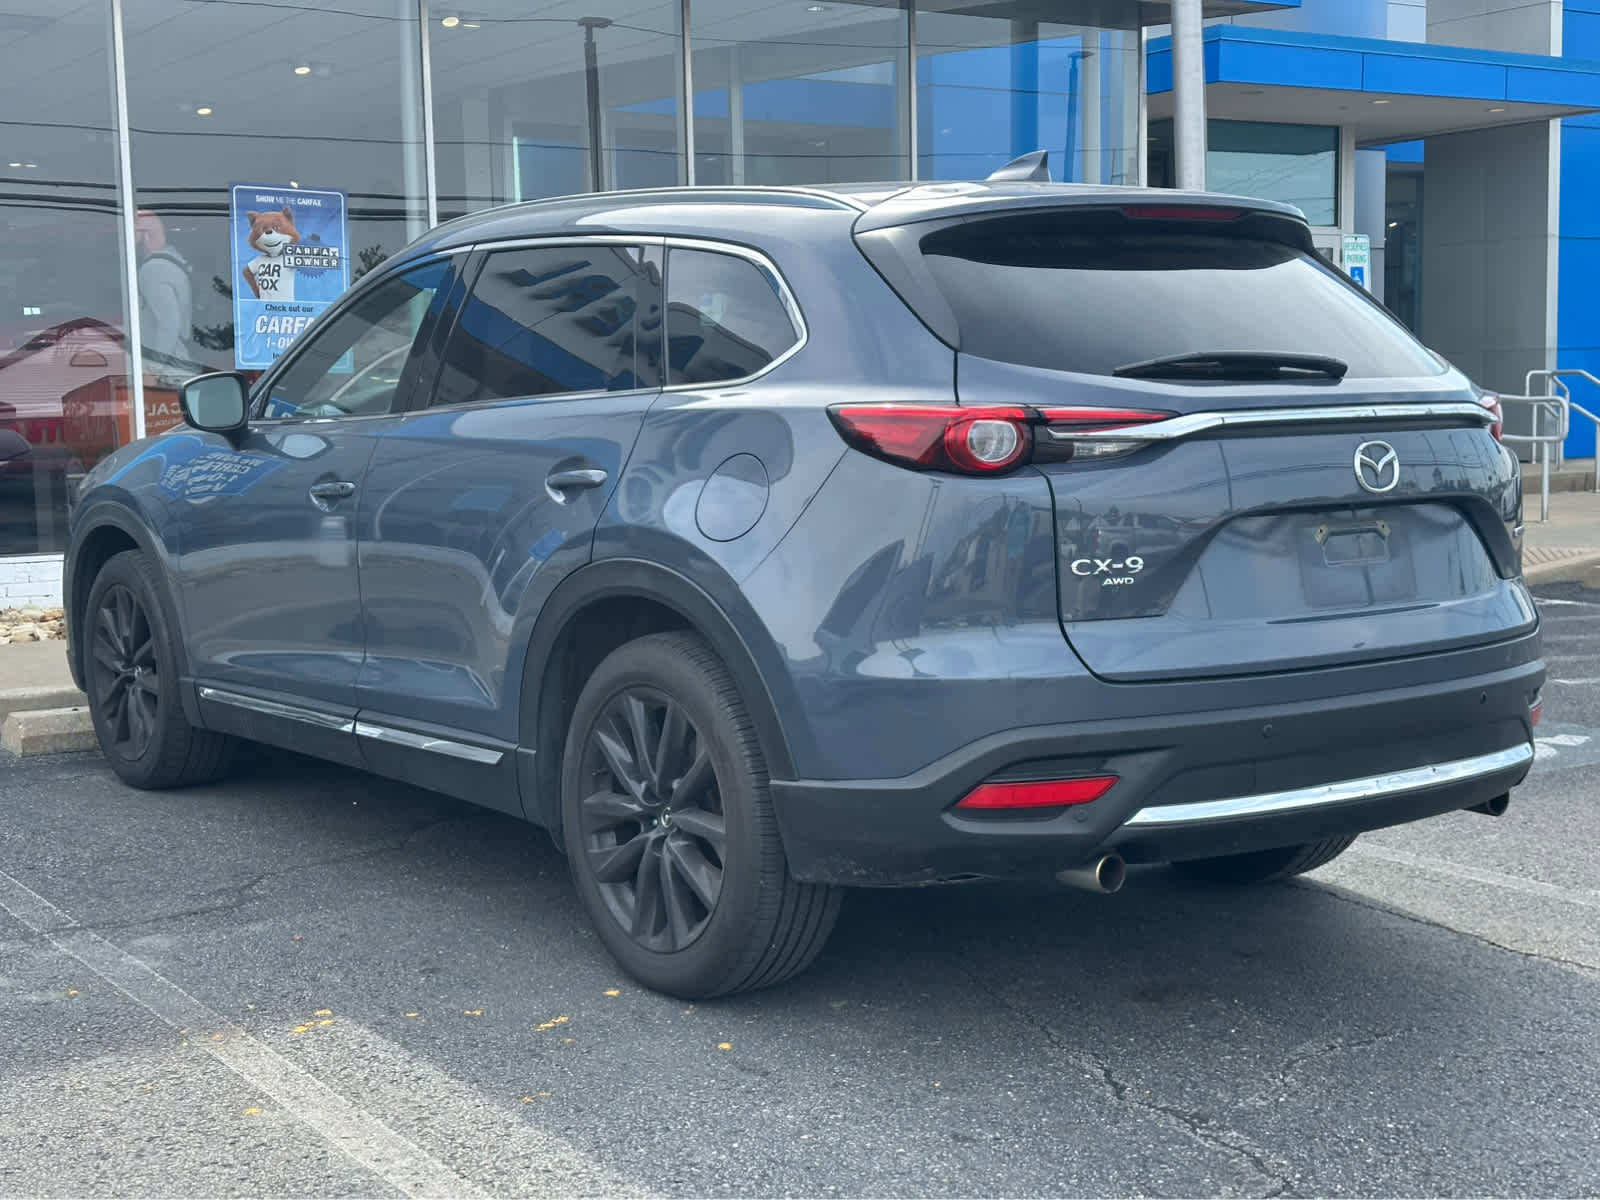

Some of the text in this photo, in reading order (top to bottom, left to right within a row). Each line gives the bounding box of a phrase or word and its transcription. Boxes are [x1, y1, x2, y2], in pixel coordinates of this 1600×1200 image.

[256, 195, 274, 204] SHOW
[297, 198, 322, 207] CARFAX
[258, 263, 281, 278] CAR
[265, 303, 285, 312] Check
[288, 305, 300, 313] out
[1071, 556, 1144, 576] CX-9
[1102, 577, 1134, 586] AWD
